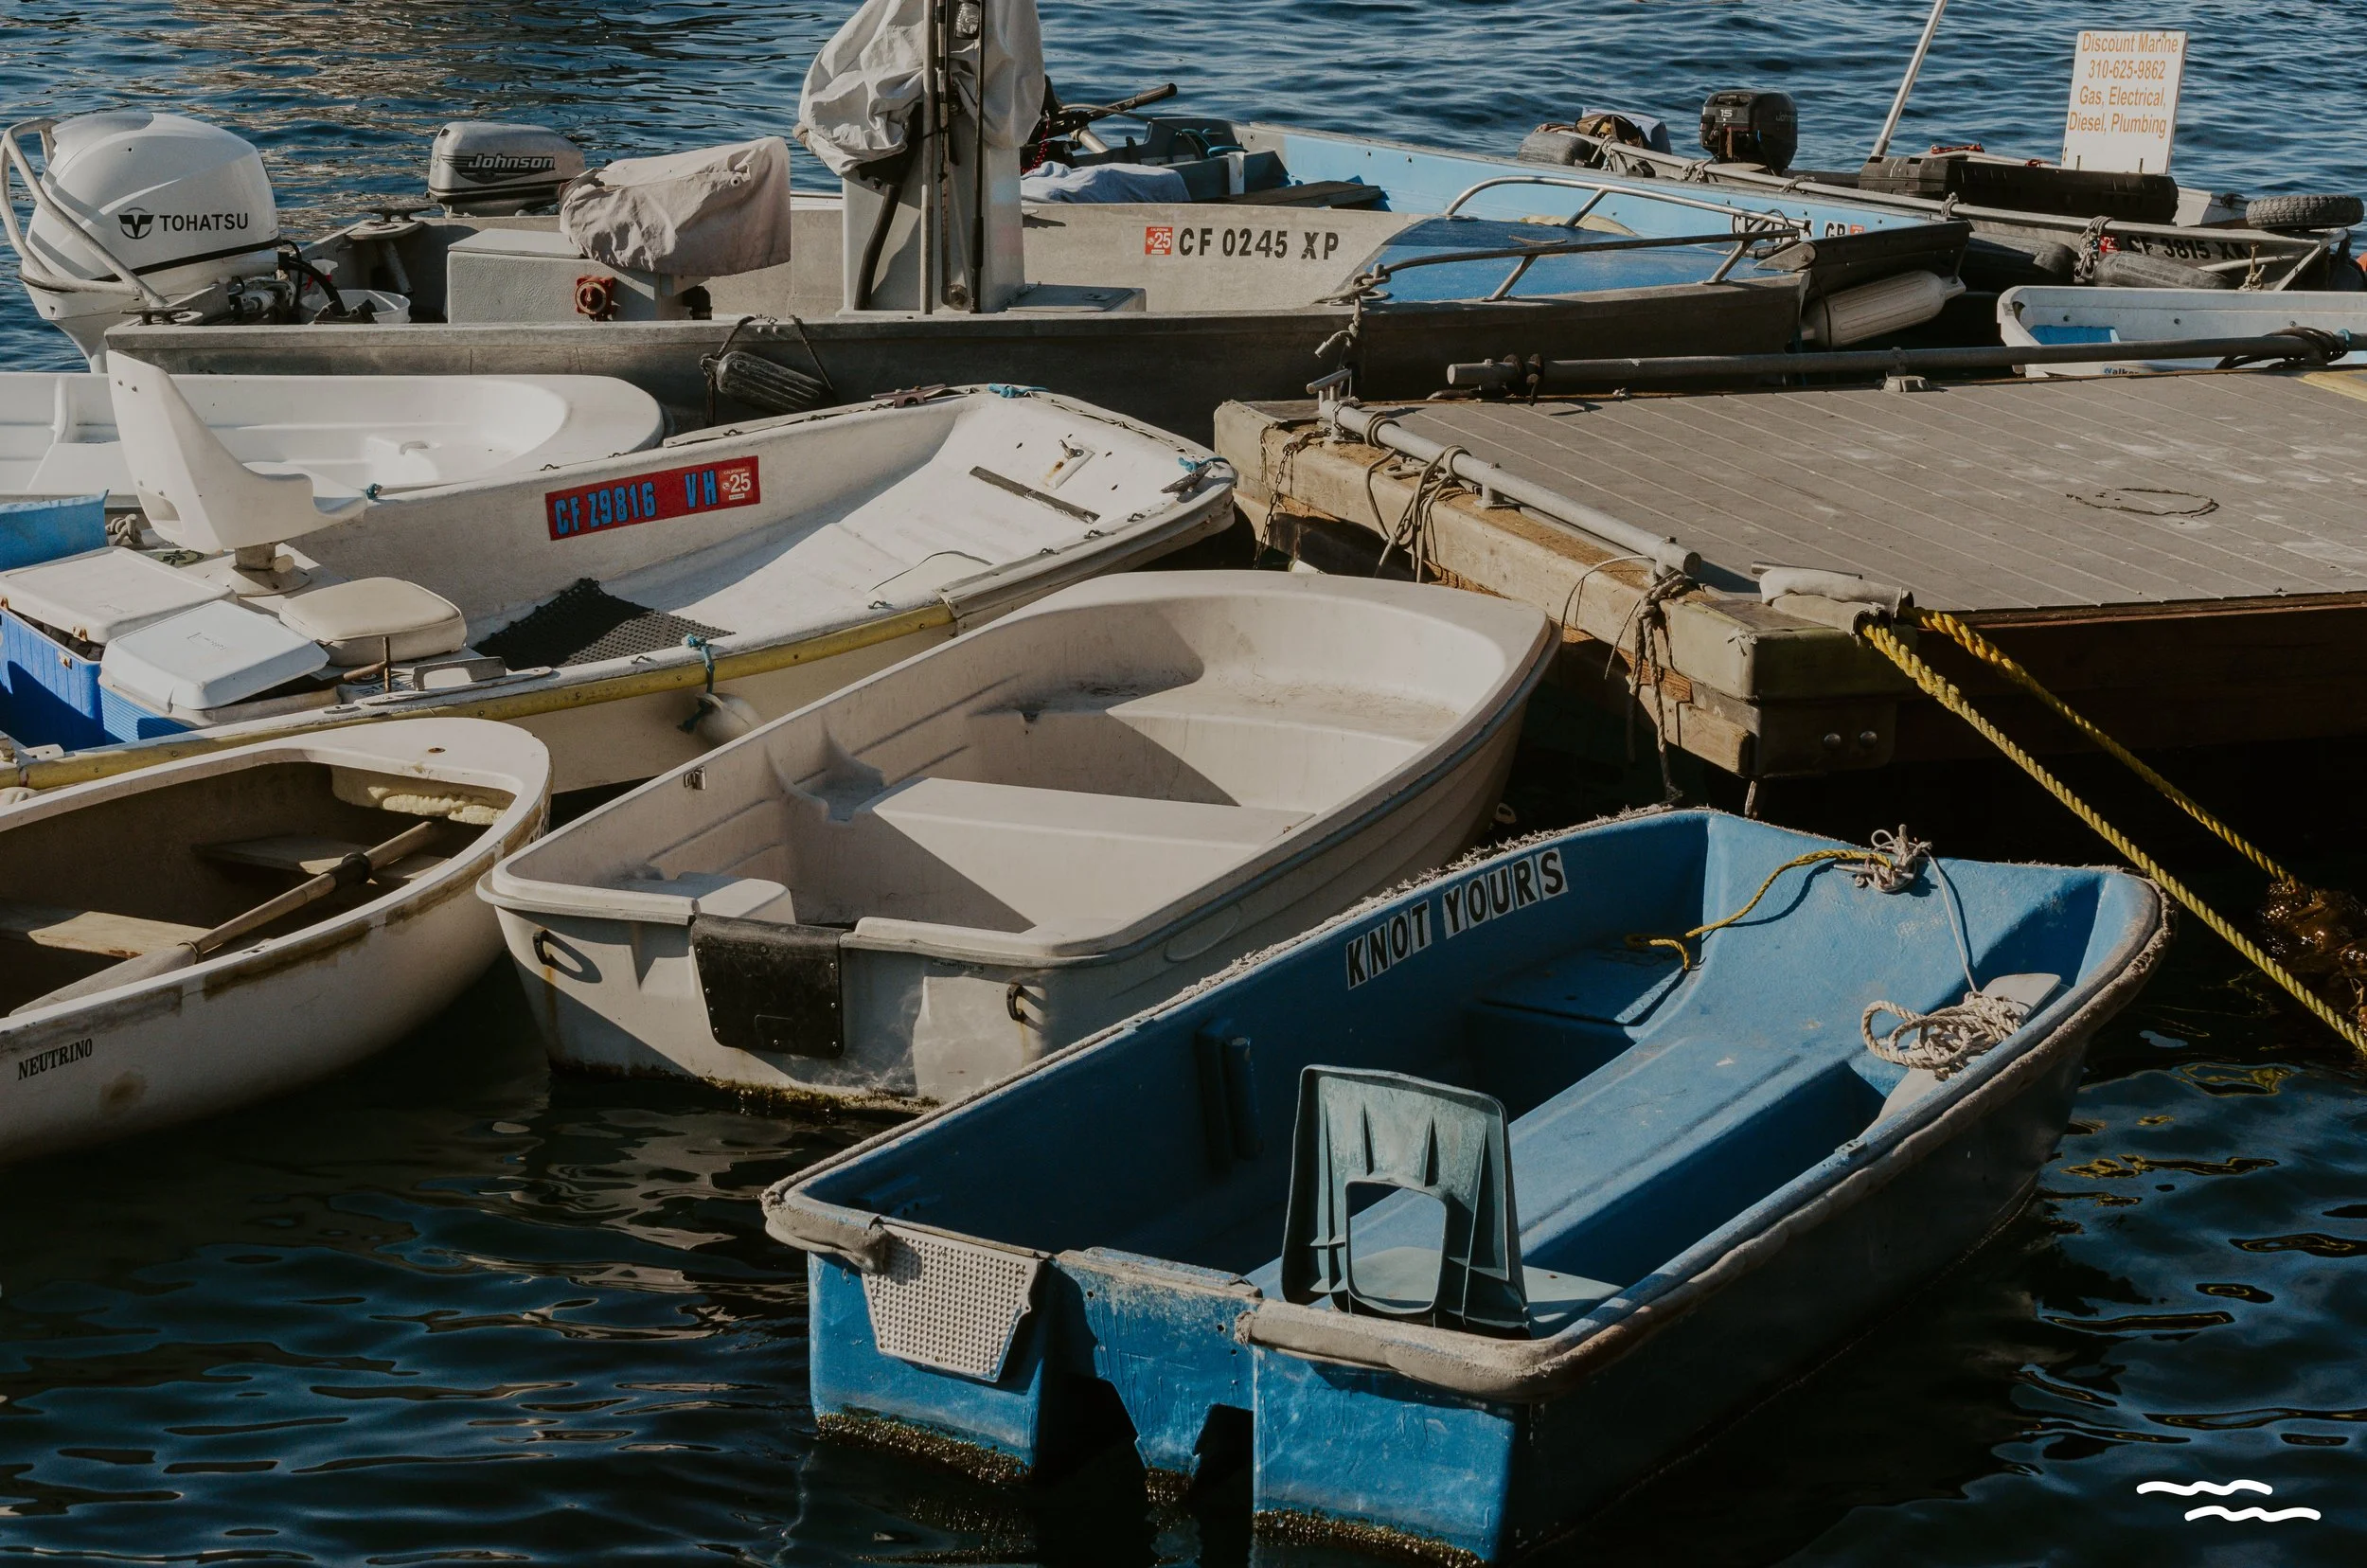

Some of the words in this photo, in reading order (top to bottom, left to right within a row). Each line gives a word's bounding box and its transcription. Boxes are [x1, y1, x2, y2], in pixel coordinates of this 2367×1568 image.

[2082, 32, 2135, 53] Discount
[2138, 32, 2178, 53] Marine
[2089, 59, 2166, 80] 310-625-9862
[2079, 85, 2105, 107] Gas,
[2109, 86, 2166, 110] Electrical,
[1720, 109, 1733, 117] 15
[2069, 112, 2107, 135] Diesel,
[2110, 113, 2167, 139] Plumbing
[468, 153, 555, 169] Johnson
[159, 213, 248, 231] TOHATSU
[1153, 232, 1171, 249] 25
[1179, 227, 1213, 256] CF
[1222, 227, 1288, 258] 0245
[1301, 232, 1339, 260] XP
[2127, 236, 2154, 256] CF
[2159, 238, 2212, 259] 3815
[729, 472, 752, 492] 25
[554, 496, 581, 535] CF
[587, 481, 657, 528] Z9816
[685, 470, 718, 508] VH
[1347, 901, 1428, 987] KNOT
[1444, 851, 1564, 934] YOURS
[18, 1038, 93, 1080] NEUTRINO
